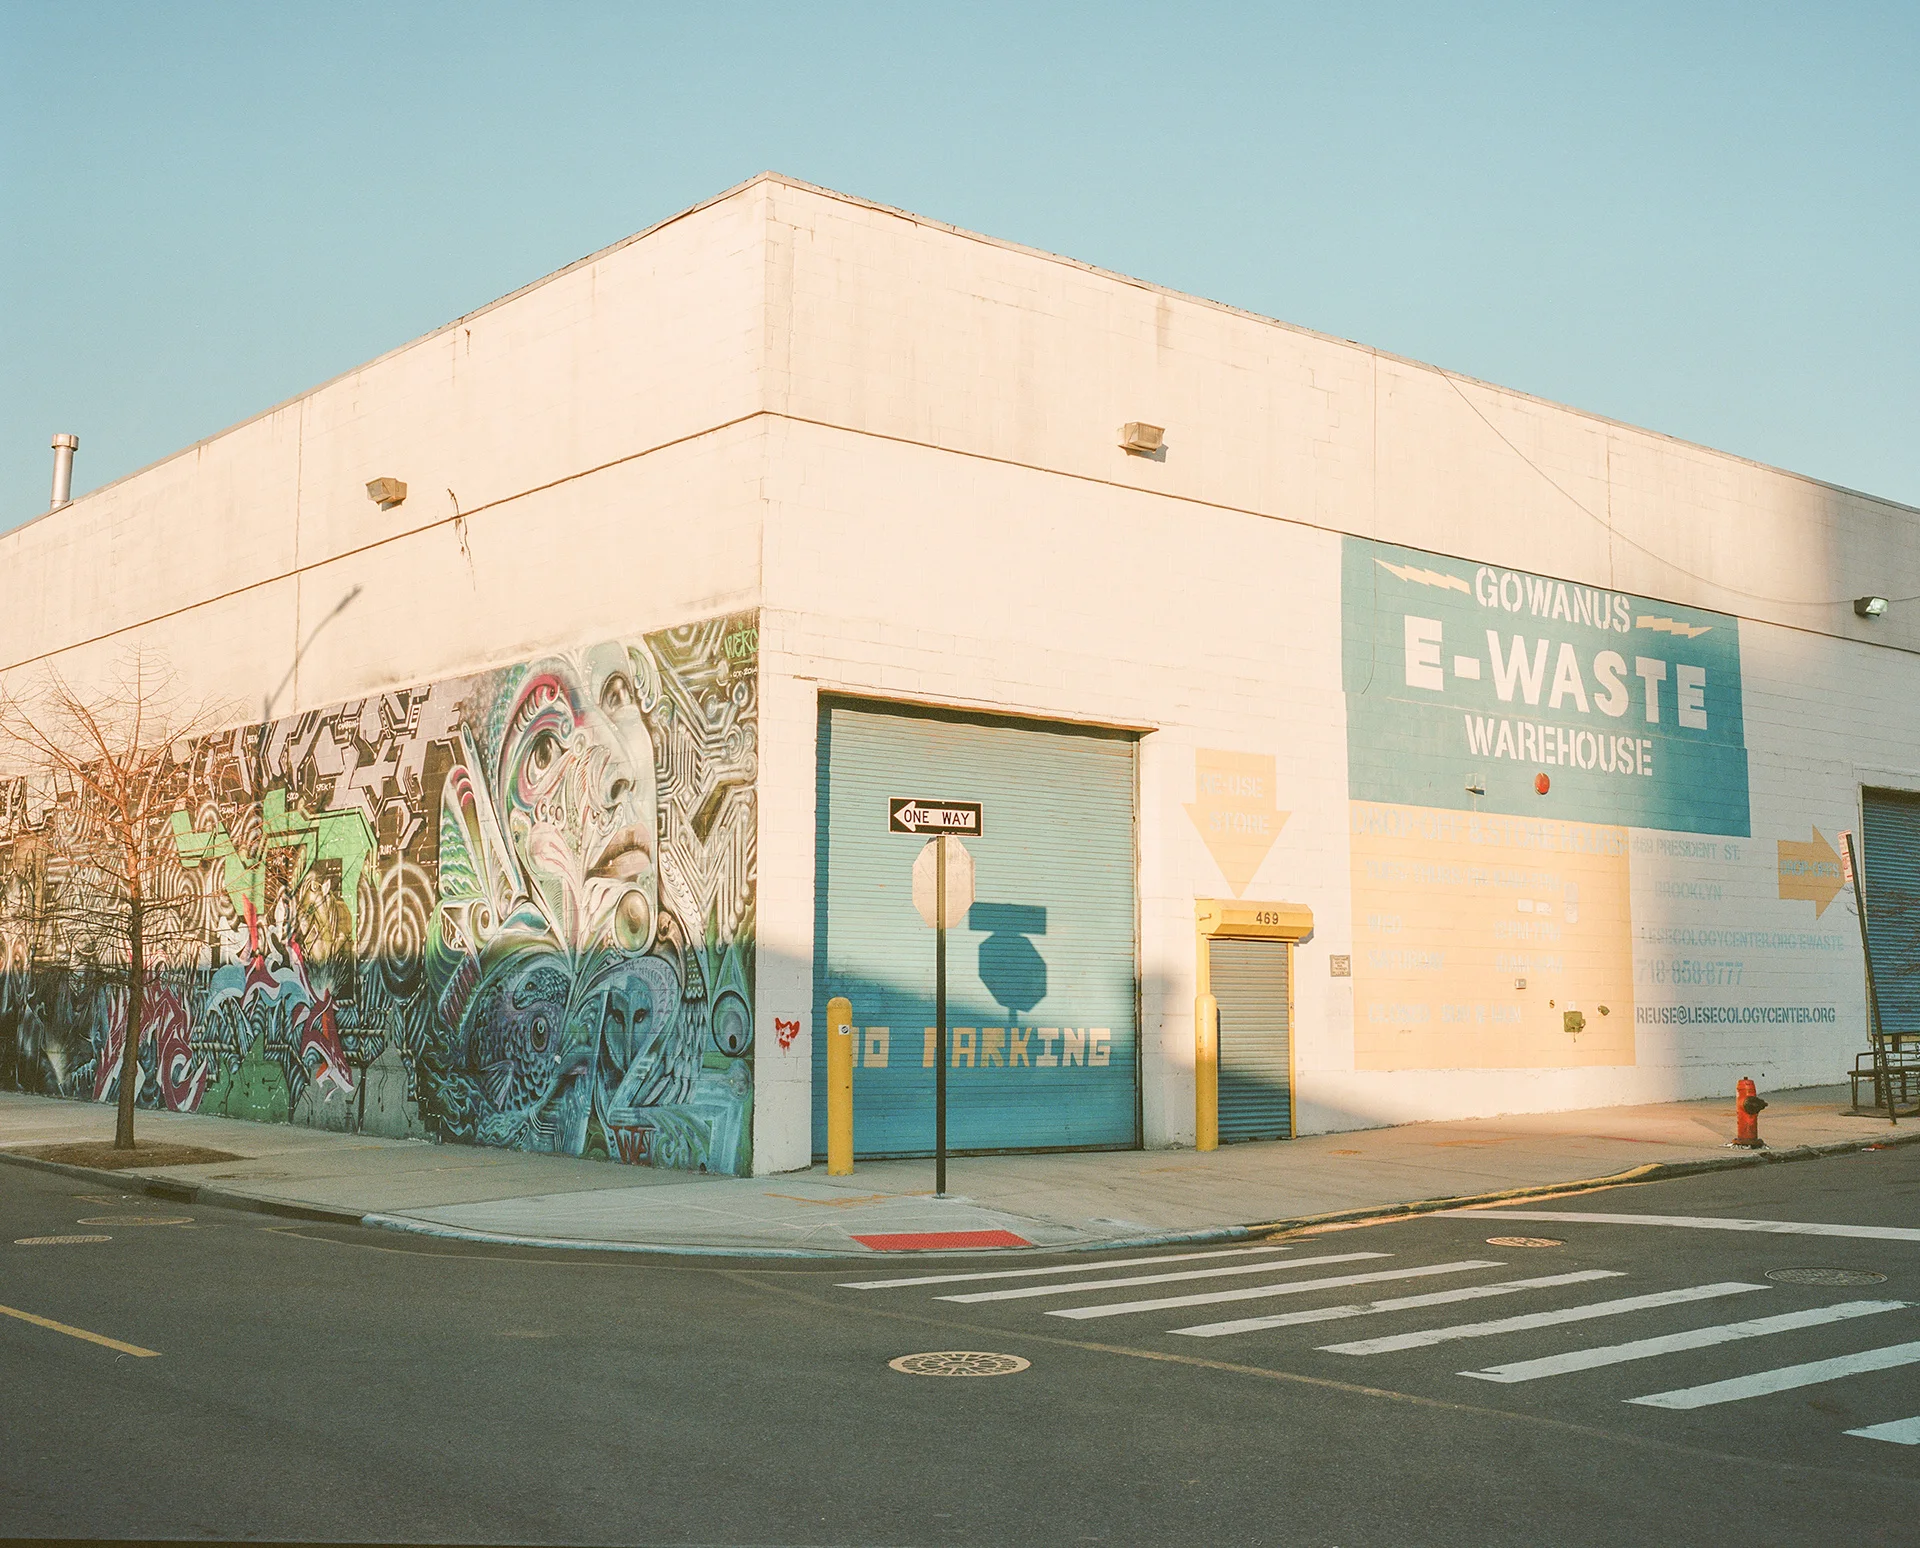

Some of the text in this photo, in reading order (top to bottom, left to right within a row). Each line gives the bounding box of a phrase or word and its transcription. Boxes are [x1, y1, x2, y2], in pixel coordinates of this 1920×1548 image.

[1476, 566, 1630, 633] GOWANUS
[1404, 614, 1707, 731] E-WASTE
[1465, 715, 1652, 777] WAREHOUSE
[1199, 771, 1264, 798] RE-USE
[903, 809, 970, 826] ONE WAY
[1209, 811, 1269, 836] STORE
[1351, 805, 1463, 840] DROP-OFF
[1487, 819, 1557, 851] STORE
[1657, 838, 1717, 860] PRESIDENT
[1780, 860, 1840, 879] DROP-OFFS
[1655, 880, 1723, 901] BROOKLYN
[1256, 912, 1279, 925] 469
[1366, 914, 1403, 935] WED
[1367, 948, 1445, 971] SATURDAY
[1367, 1002, 1431, 1024] CLOSED
[1440, 1003, 1470, 1024] SUN
[1636, 1005, 1836, 1025] REUSE@LESECOLOGYCENTER.ORG
